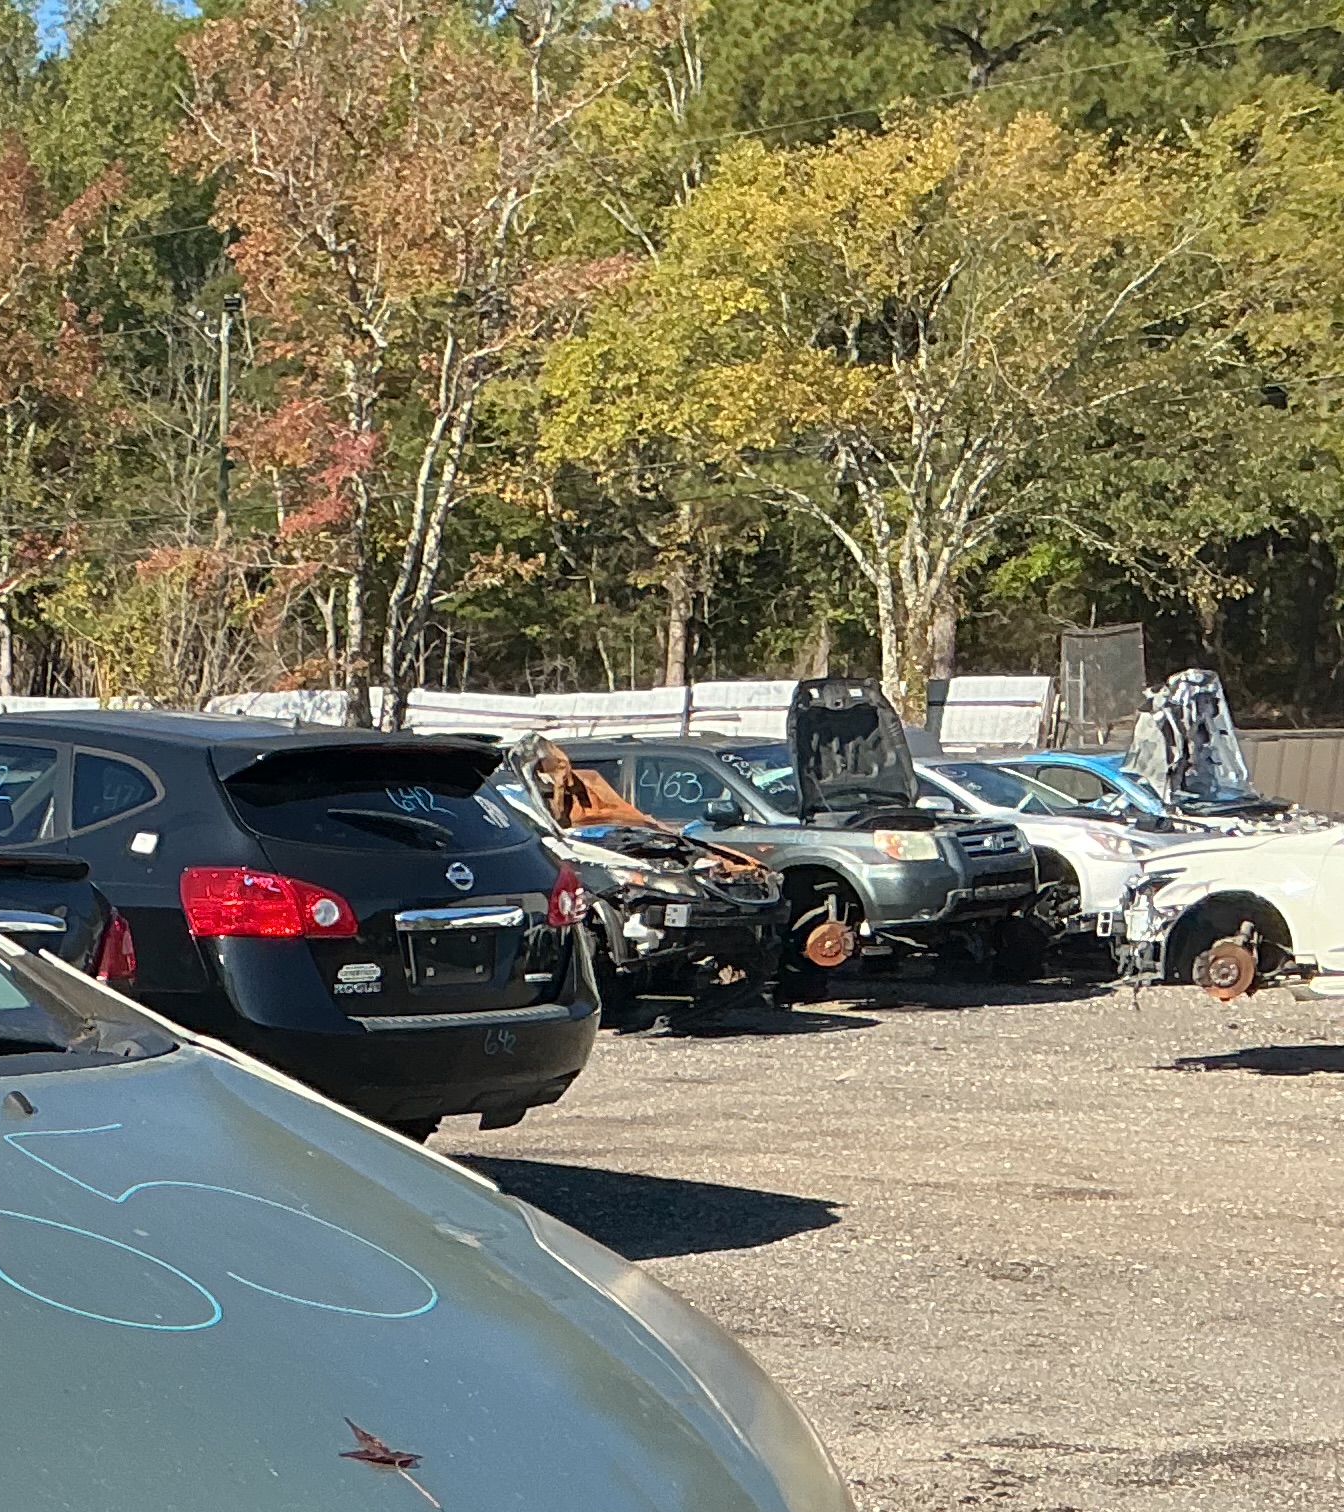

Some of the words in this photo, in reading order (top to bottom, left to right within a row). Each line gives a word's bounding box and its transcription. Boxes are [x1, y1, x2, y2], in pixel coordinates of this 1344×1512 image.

[385, 785, 459, 819] 642
[639, 769, 704, 803] 463
[484, 1028, 517, 1055] 642
